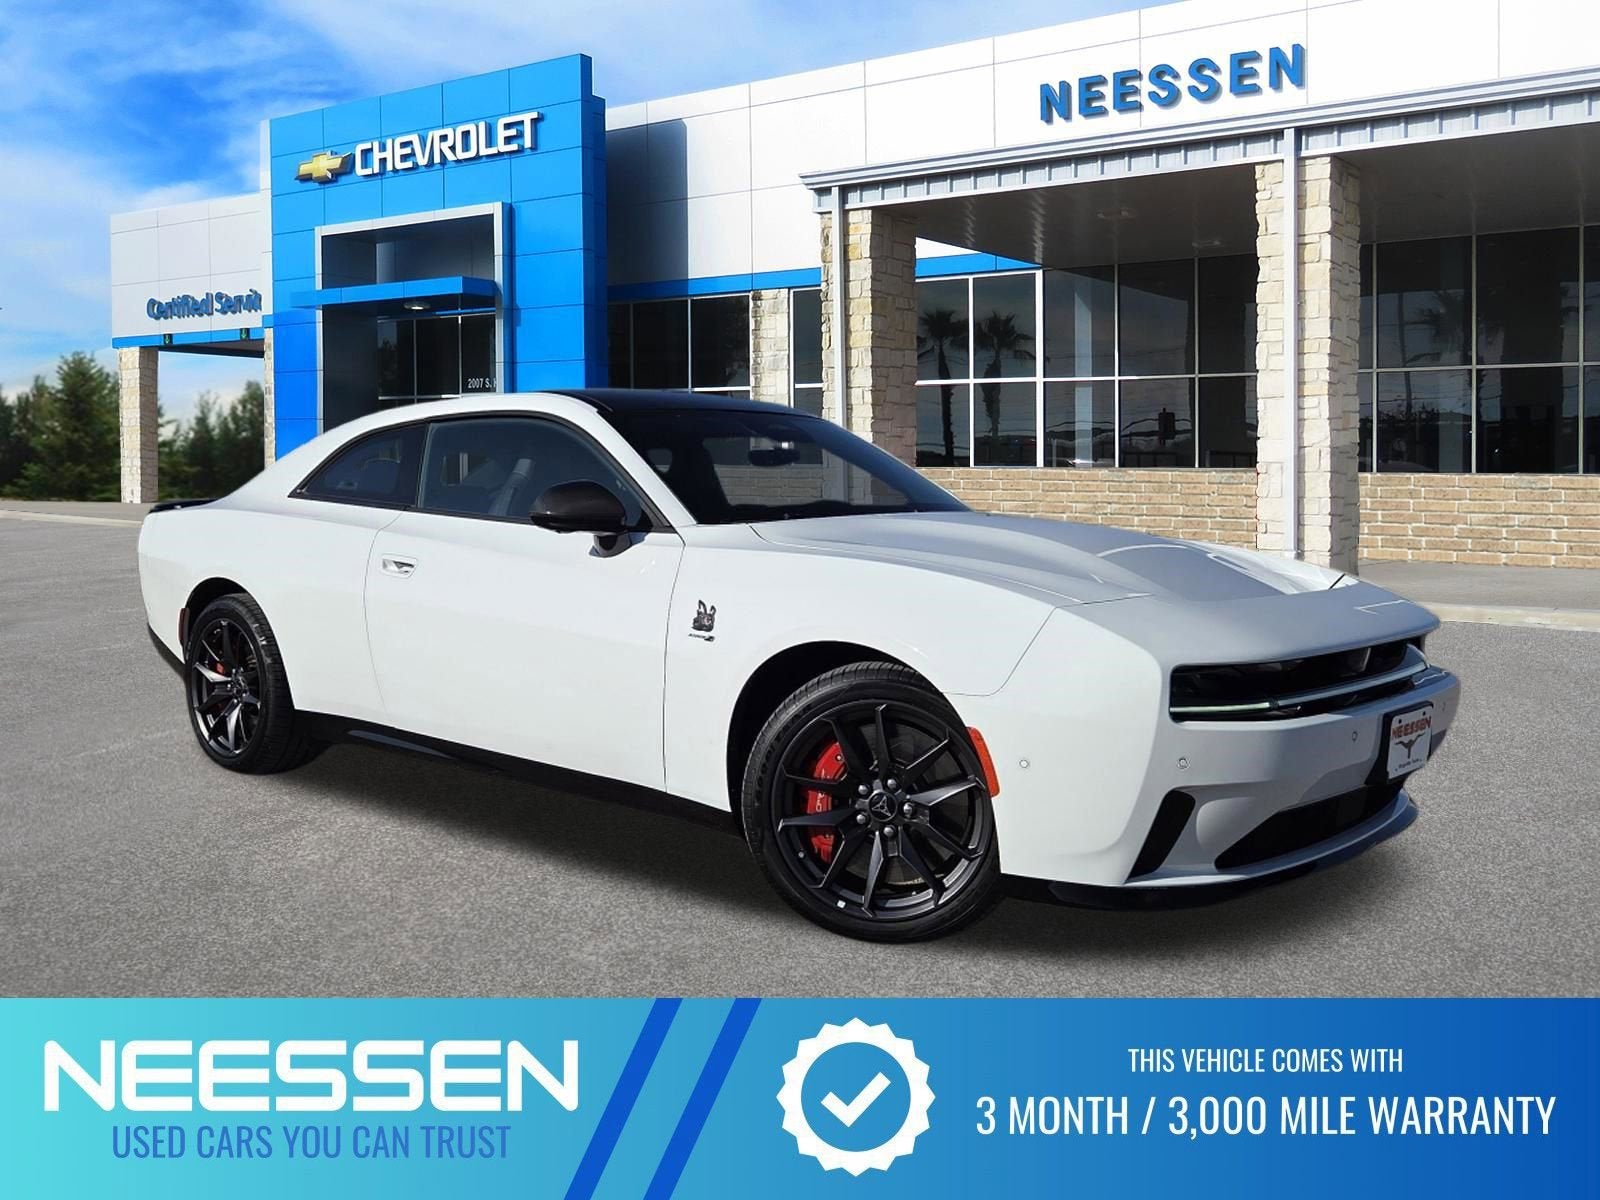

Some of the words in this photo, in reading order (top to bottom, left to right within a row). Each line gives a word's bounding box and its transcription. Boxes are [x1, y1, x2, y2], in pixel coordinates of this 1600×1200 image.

[1040, 43, 1305, 125] NEESSEN
[355, 111, 543, 177] CHEVROLET
[147, 292, 213, 320] Certified
[467, 377, 483, 389] 2007
